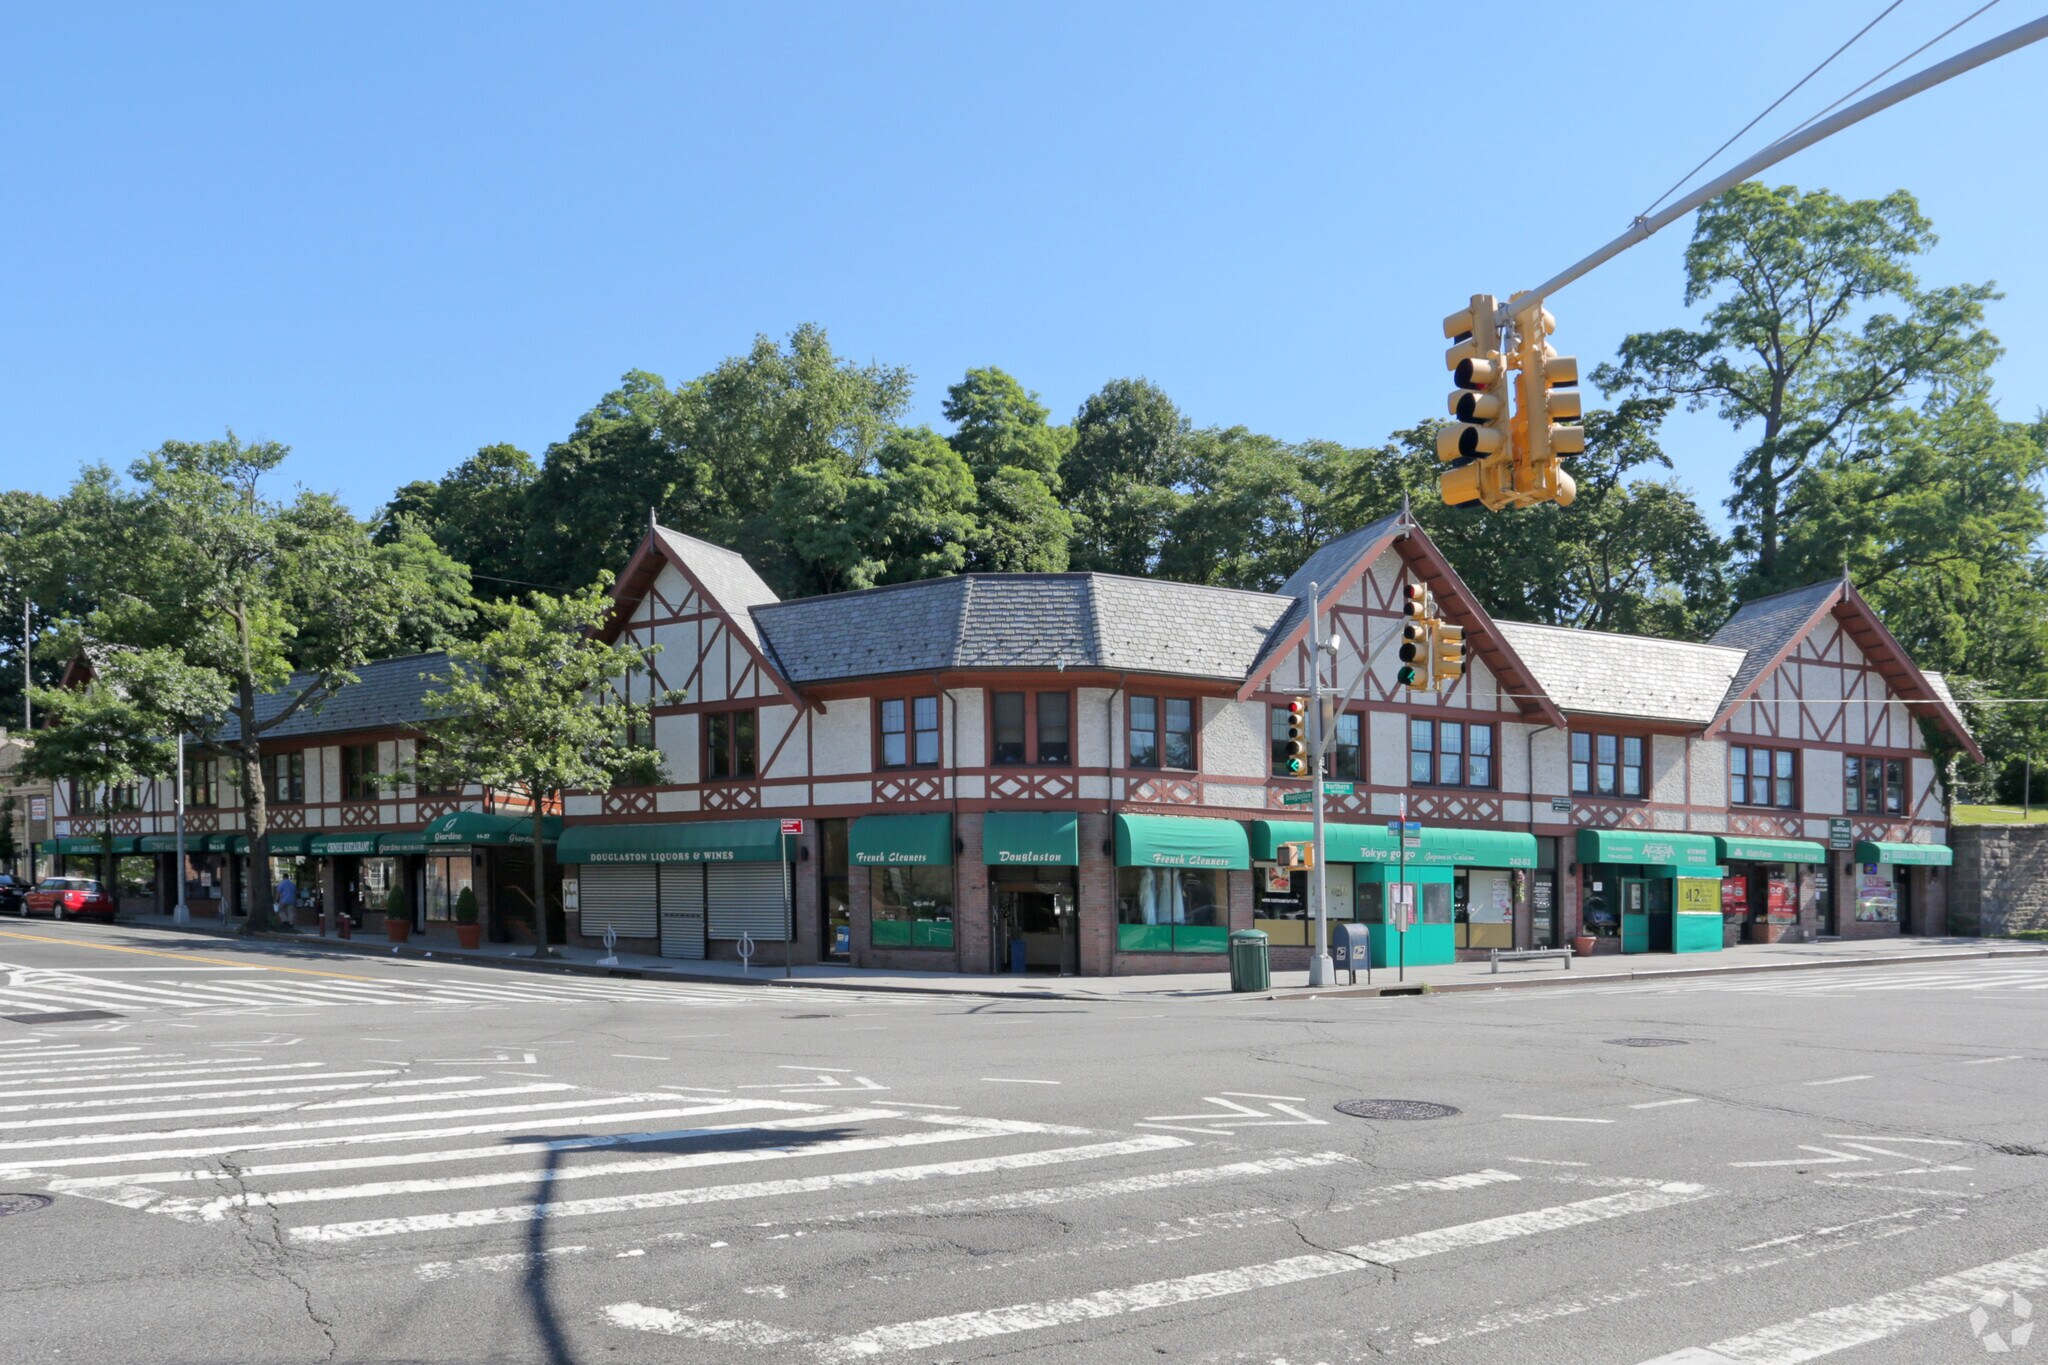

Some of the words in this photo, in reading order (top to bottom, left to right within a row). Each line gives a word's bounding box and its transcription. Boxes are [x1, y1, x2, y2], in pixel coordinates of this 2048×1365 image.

[590, 853, 648, 861] DOUGLASTON
[651, 852, 690, 862] LIQUORS
[693, 852, 700, 860] &
[704, 851, 734, 860] WINES
[856, 852, 885, 862] French
[888, 852, 927, 862] Cleaners
[999, 851, 1062, 862] Douglaston
[1153, 853, 1185, 864] French
[1189, 855, 1229, 866] Cleaners
[1361, 847, 1387, 860] Tokyo
[1390, 850, 1401, 861] go
